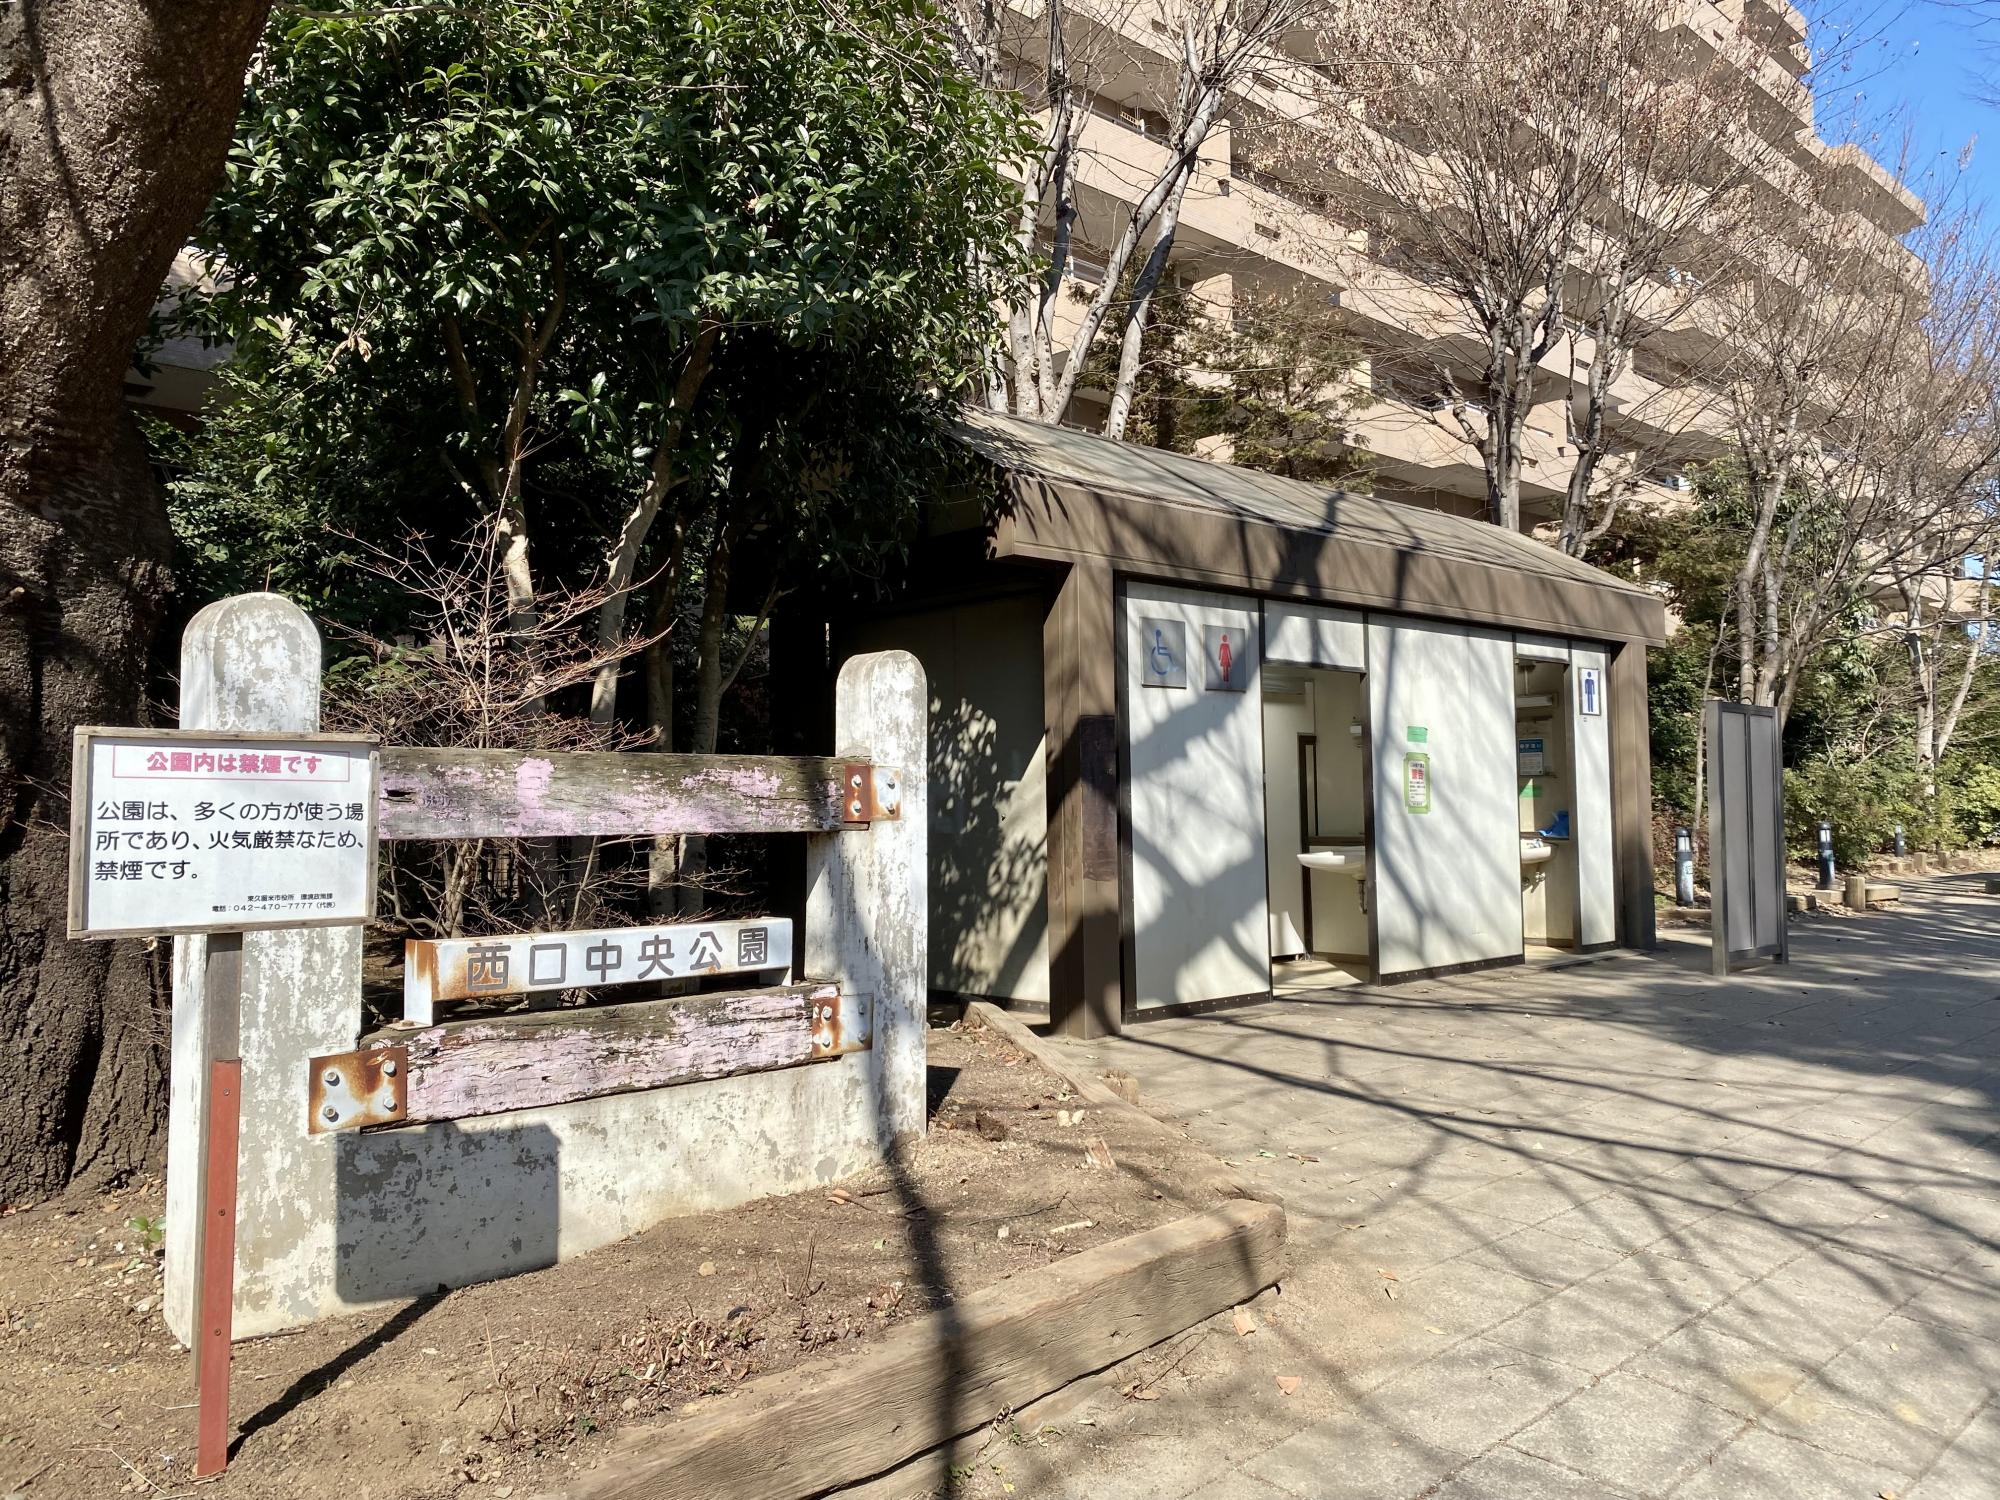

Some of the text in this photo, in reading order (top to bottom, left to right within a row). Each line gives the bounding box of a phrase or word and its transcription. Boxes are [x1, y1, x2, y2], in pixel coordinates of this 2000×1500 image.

[146, 752, 323, 774] 公園内は禁煙です
[96, 801, 364, 821] 公園は、多くの方が使う場
[95, 829, 364, 851] 所であり、火気厳禁なため、
[94, 860, 200, 881] 禁煙です。
[467, 927, 768, 992] 西口中央公園
